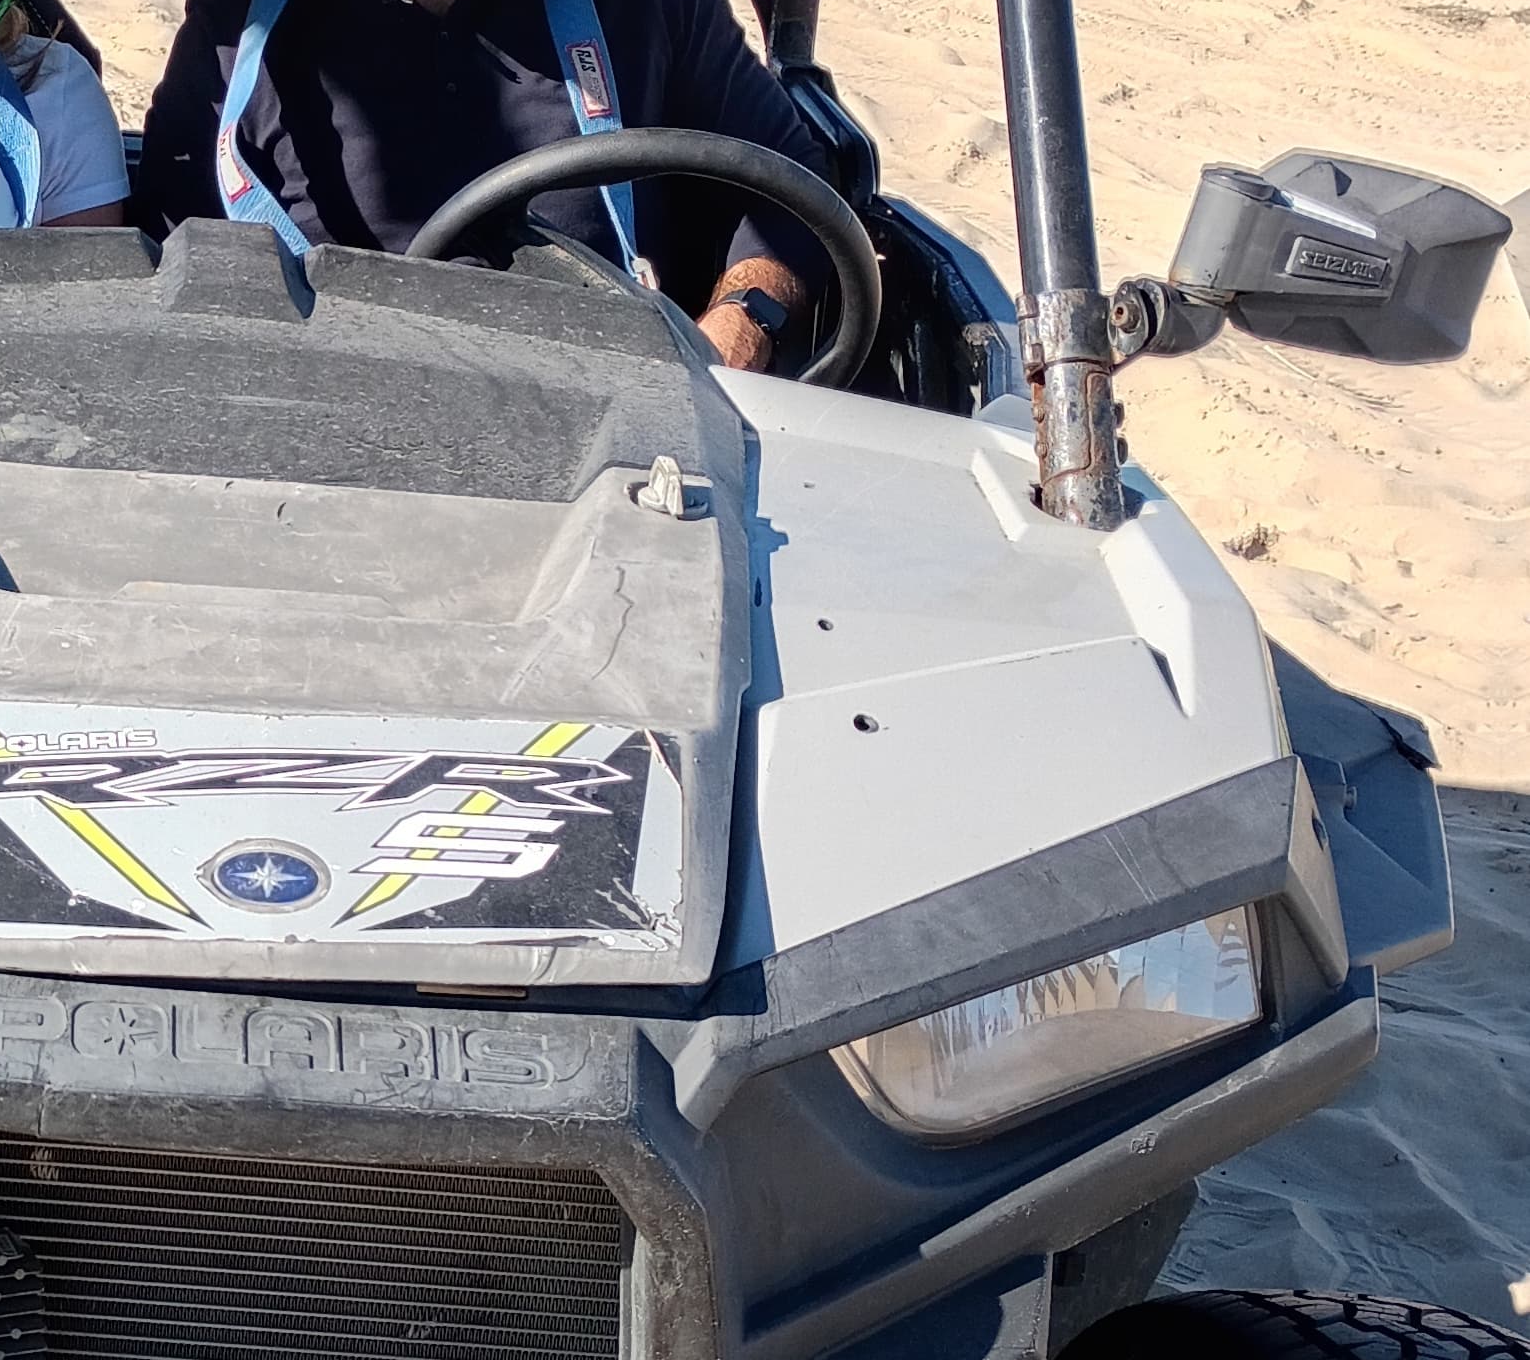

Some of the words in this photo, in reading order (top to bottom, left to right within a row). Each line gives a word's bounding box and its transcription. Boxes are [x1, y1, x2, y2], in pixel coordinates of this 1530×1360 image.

[575, 49, 597, 73] RJS
[1299, 249, 1381, 279] SEIZMIK
[354, 811, 566, 878] S
